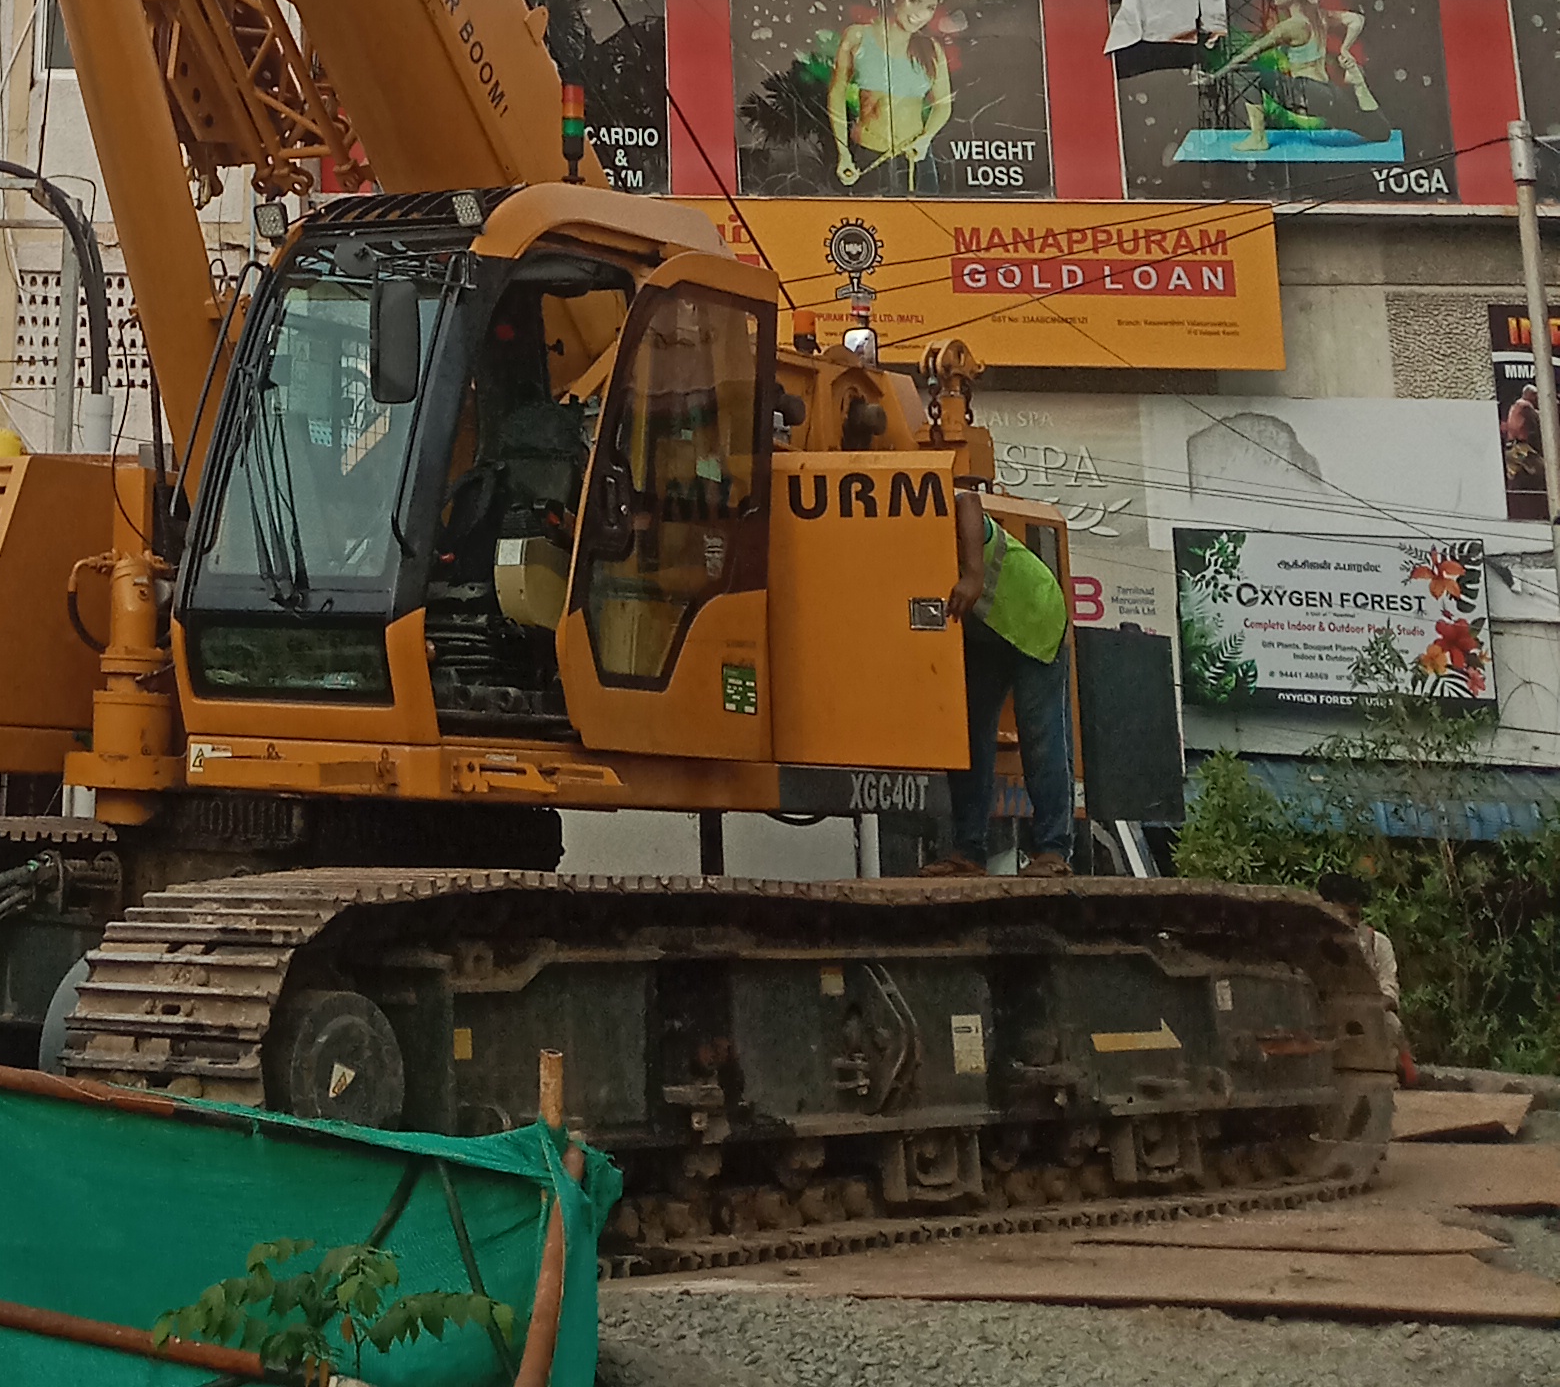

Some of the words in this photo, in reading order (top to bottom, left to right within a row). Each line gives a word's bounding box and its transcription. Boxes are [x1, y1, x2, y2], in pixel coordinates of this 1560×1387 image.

[459, 19, 510, 118] BOOM!
[584, 126, 659, 147] CARDIO
[949, 140, 1036, 161] WEIGHT
[615, 149, 628, 167] &
[966, 166, 1024, 186] LOSS
[1372, 167, 1450, 194] YOGA
[954, 226, 1229, 256] MANAPPURAM
[963, 263, 1085, 289] GOLD
[1103, 264, 1225, 291] LOAN
[995, 445, 1108, 488] SPA
[788, 471, 949, 519] URM
[1236, 582, 1333, 608] OXYGEN
[1340, 592, 1427, 616] FOREST
[1243, 618, 1285, 630] Complete
[1287, 620, 1316, 632] Indoor
[1318, 621, 1326, 631] &
[1328, 622, 1365, 634] Outdoor
[1397, 624, 1426, 637] Studio
[849, 772, 930, 811] XGC40T
